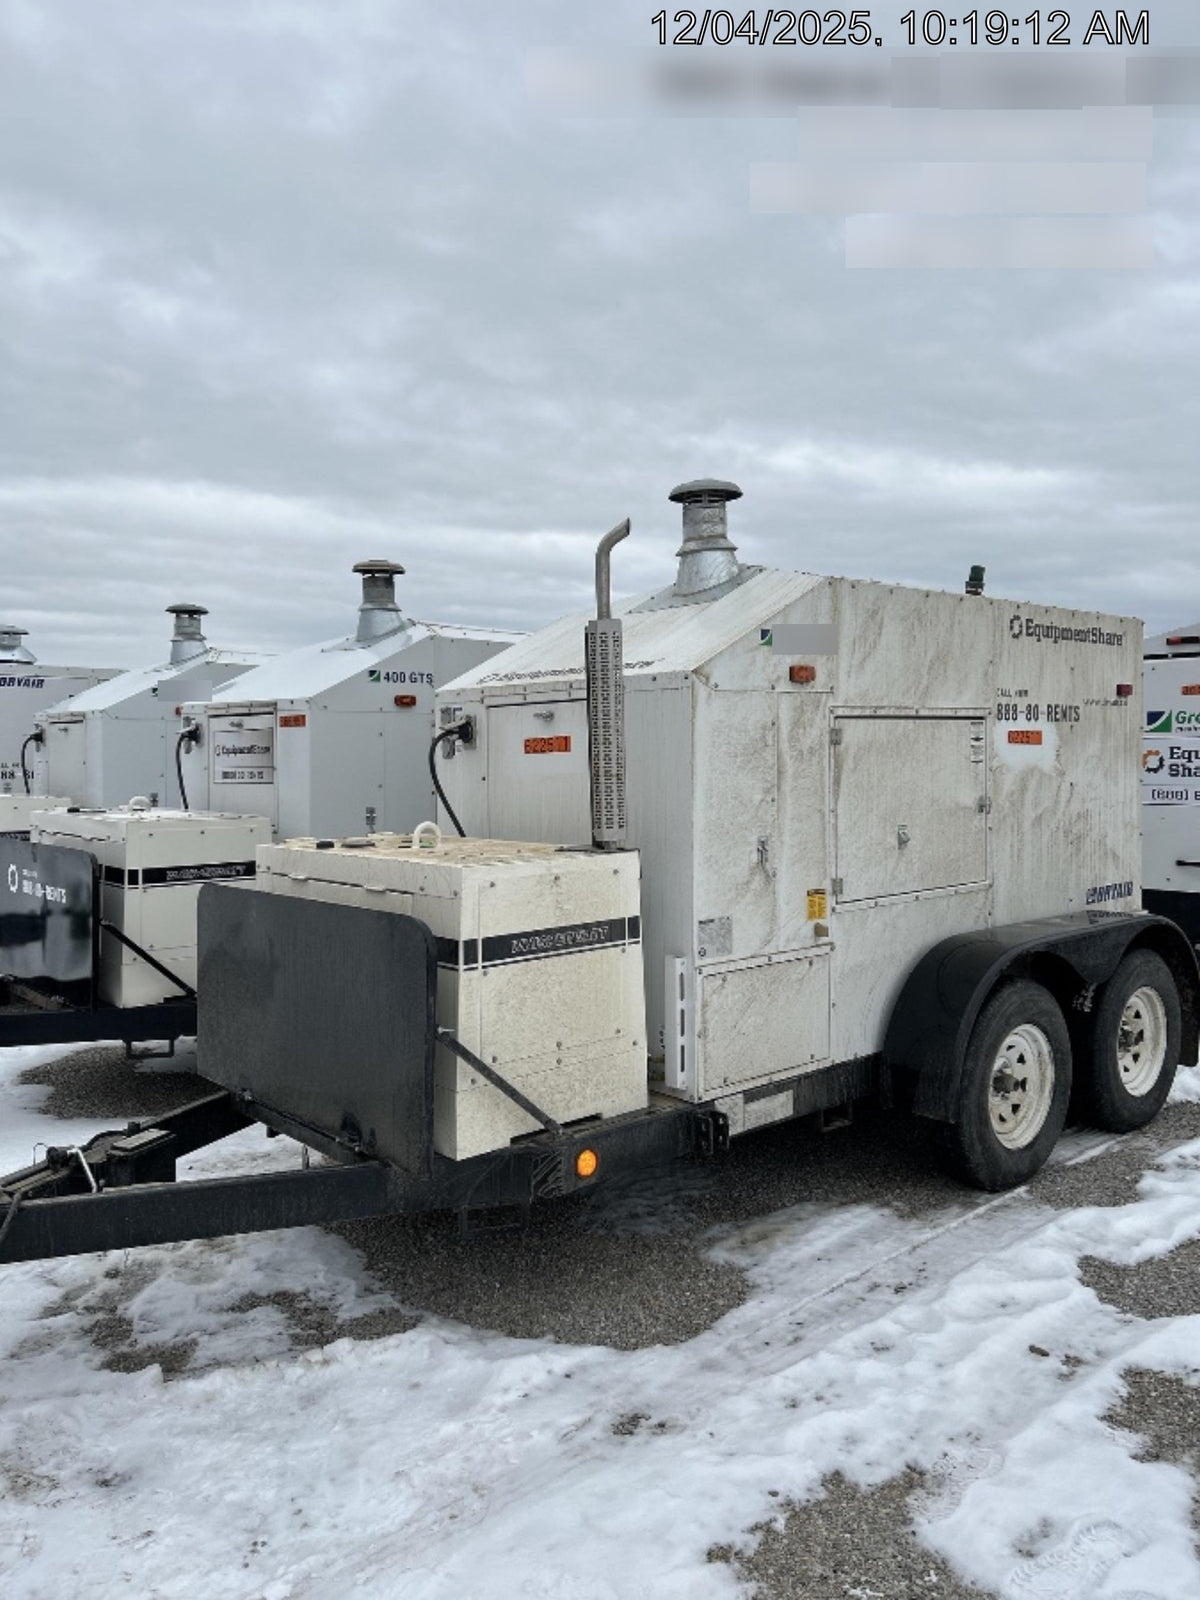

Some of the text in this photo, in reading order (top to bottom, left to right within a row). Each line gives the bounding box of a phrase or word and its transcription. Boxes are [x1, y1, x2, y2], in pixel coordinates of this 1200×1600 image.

[1025, 617, 1123, 646] EquipmentShare
[383, 671, 434, 684] 400 GTS
